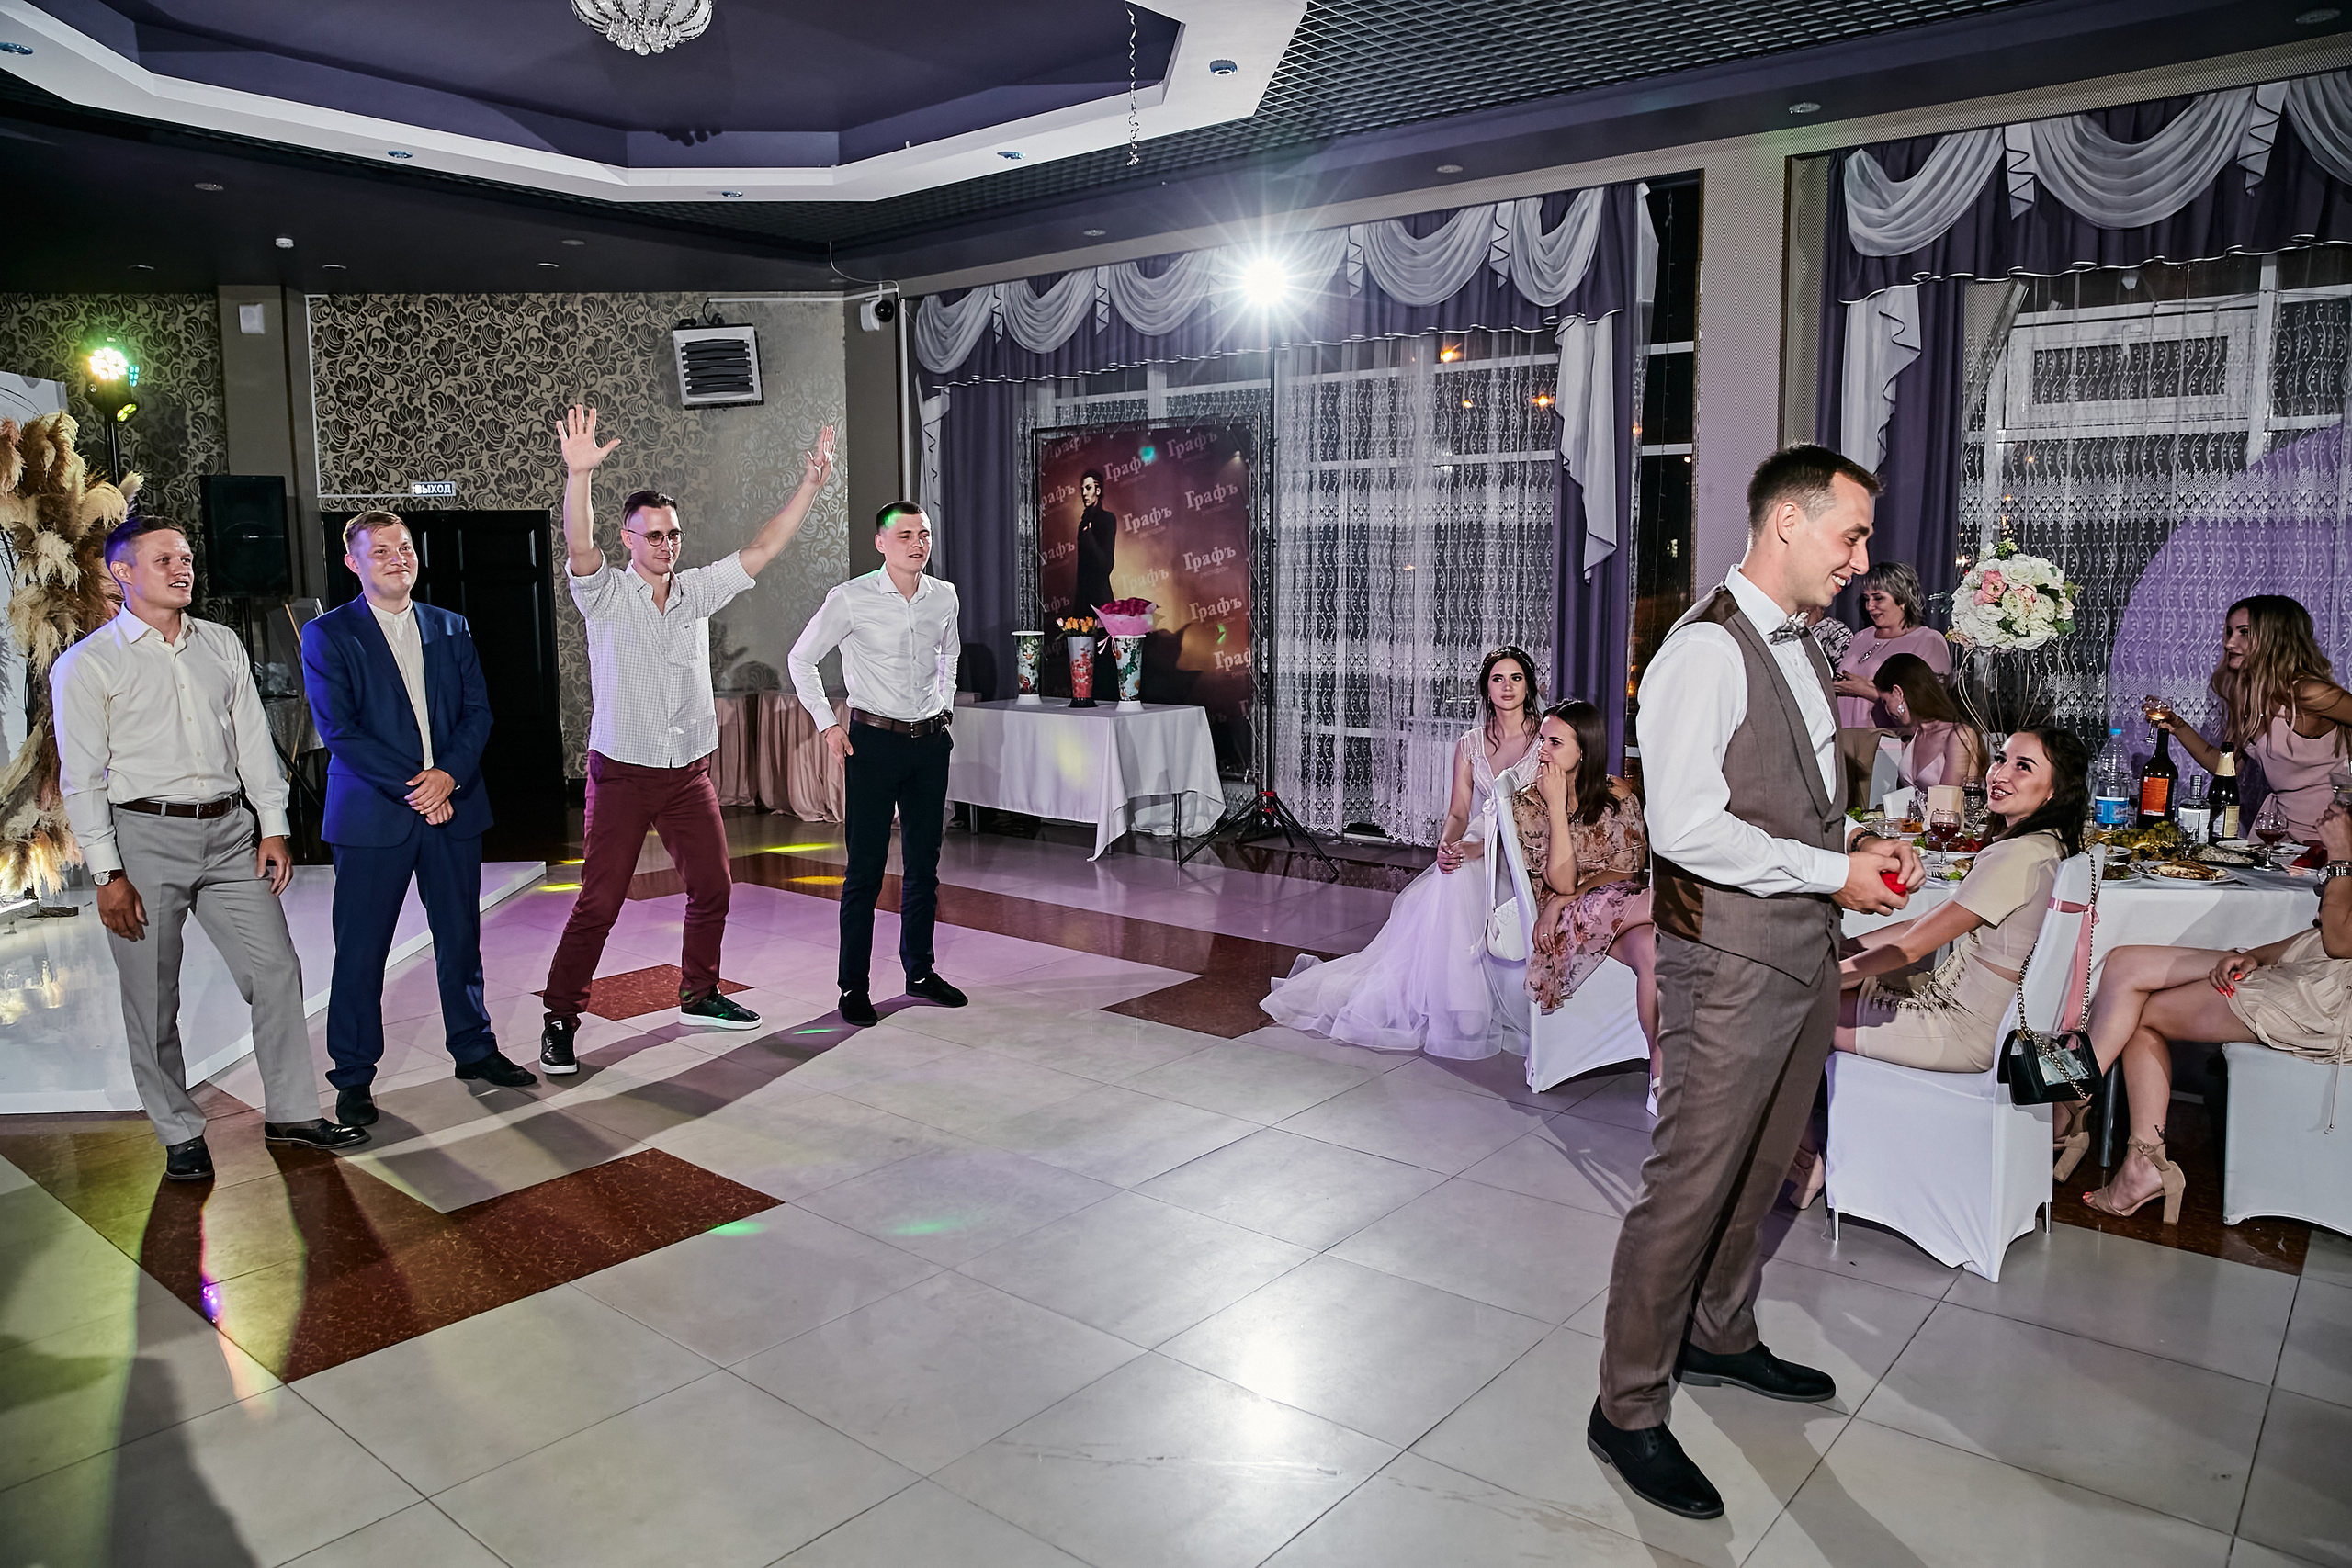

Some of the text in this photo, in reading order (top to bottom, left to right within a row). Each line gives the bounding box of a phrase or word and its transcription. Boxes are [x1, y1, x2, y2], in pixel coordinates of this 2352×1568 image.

[1166, 432, 1217, 459] Графъ
[1041, 485, 1075, 511] рафъ
[1184, 483, 1238, 511] Графъ
[1123, 506, 1172, 534] Графъ
[1040, 542, 1075, 567] рафъ
[1182, 546, 1237, 573] Графъ
[1119, 568, 1169, 594] Графъ
[1044, 596, 1069, 614] афъ
[1189, 596, 1242, 623] Графъ
[1214, 647, 1250, 672] Гра
